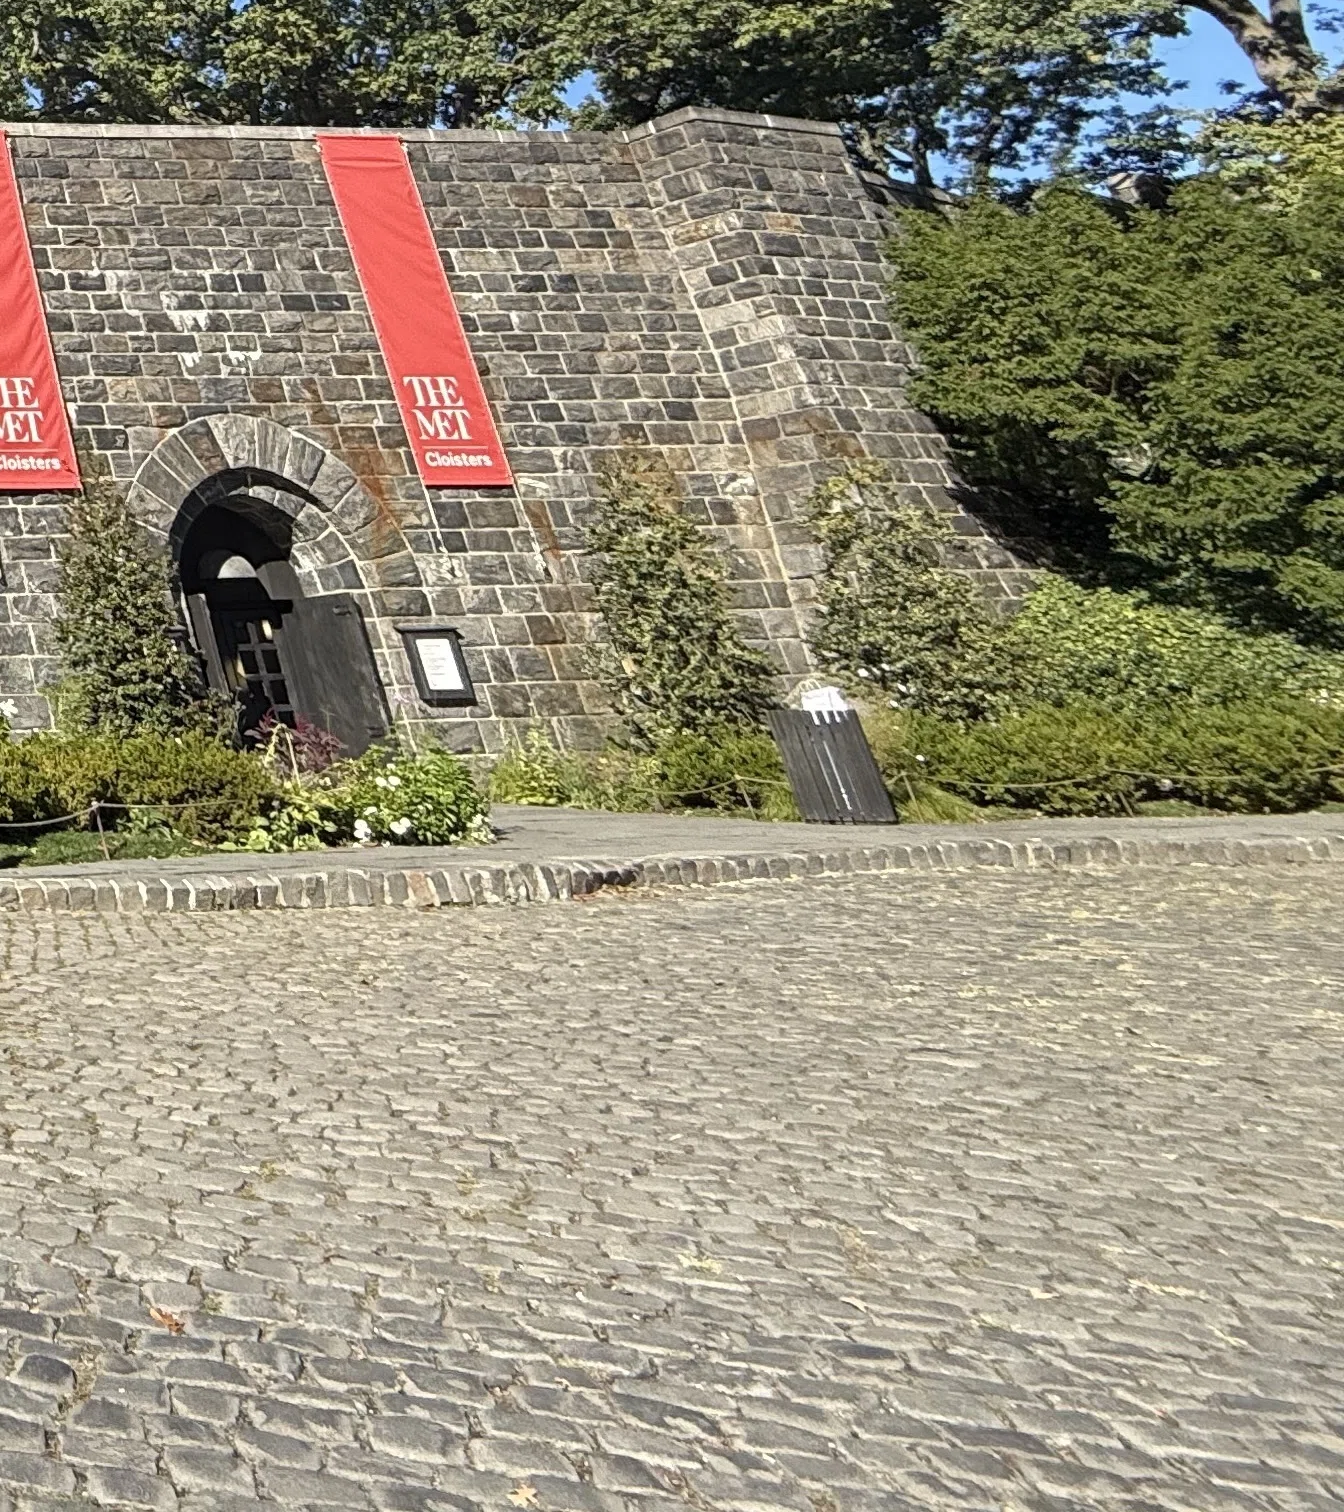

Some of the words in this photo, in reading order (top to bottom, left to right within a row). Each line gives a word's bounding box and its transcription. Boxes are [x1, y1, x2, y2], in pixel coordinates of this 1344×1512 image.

[403, 376, 464, 406] THE
[411, 409, 473, 440] MET
[425, 451, 493, 467] Cloisters
